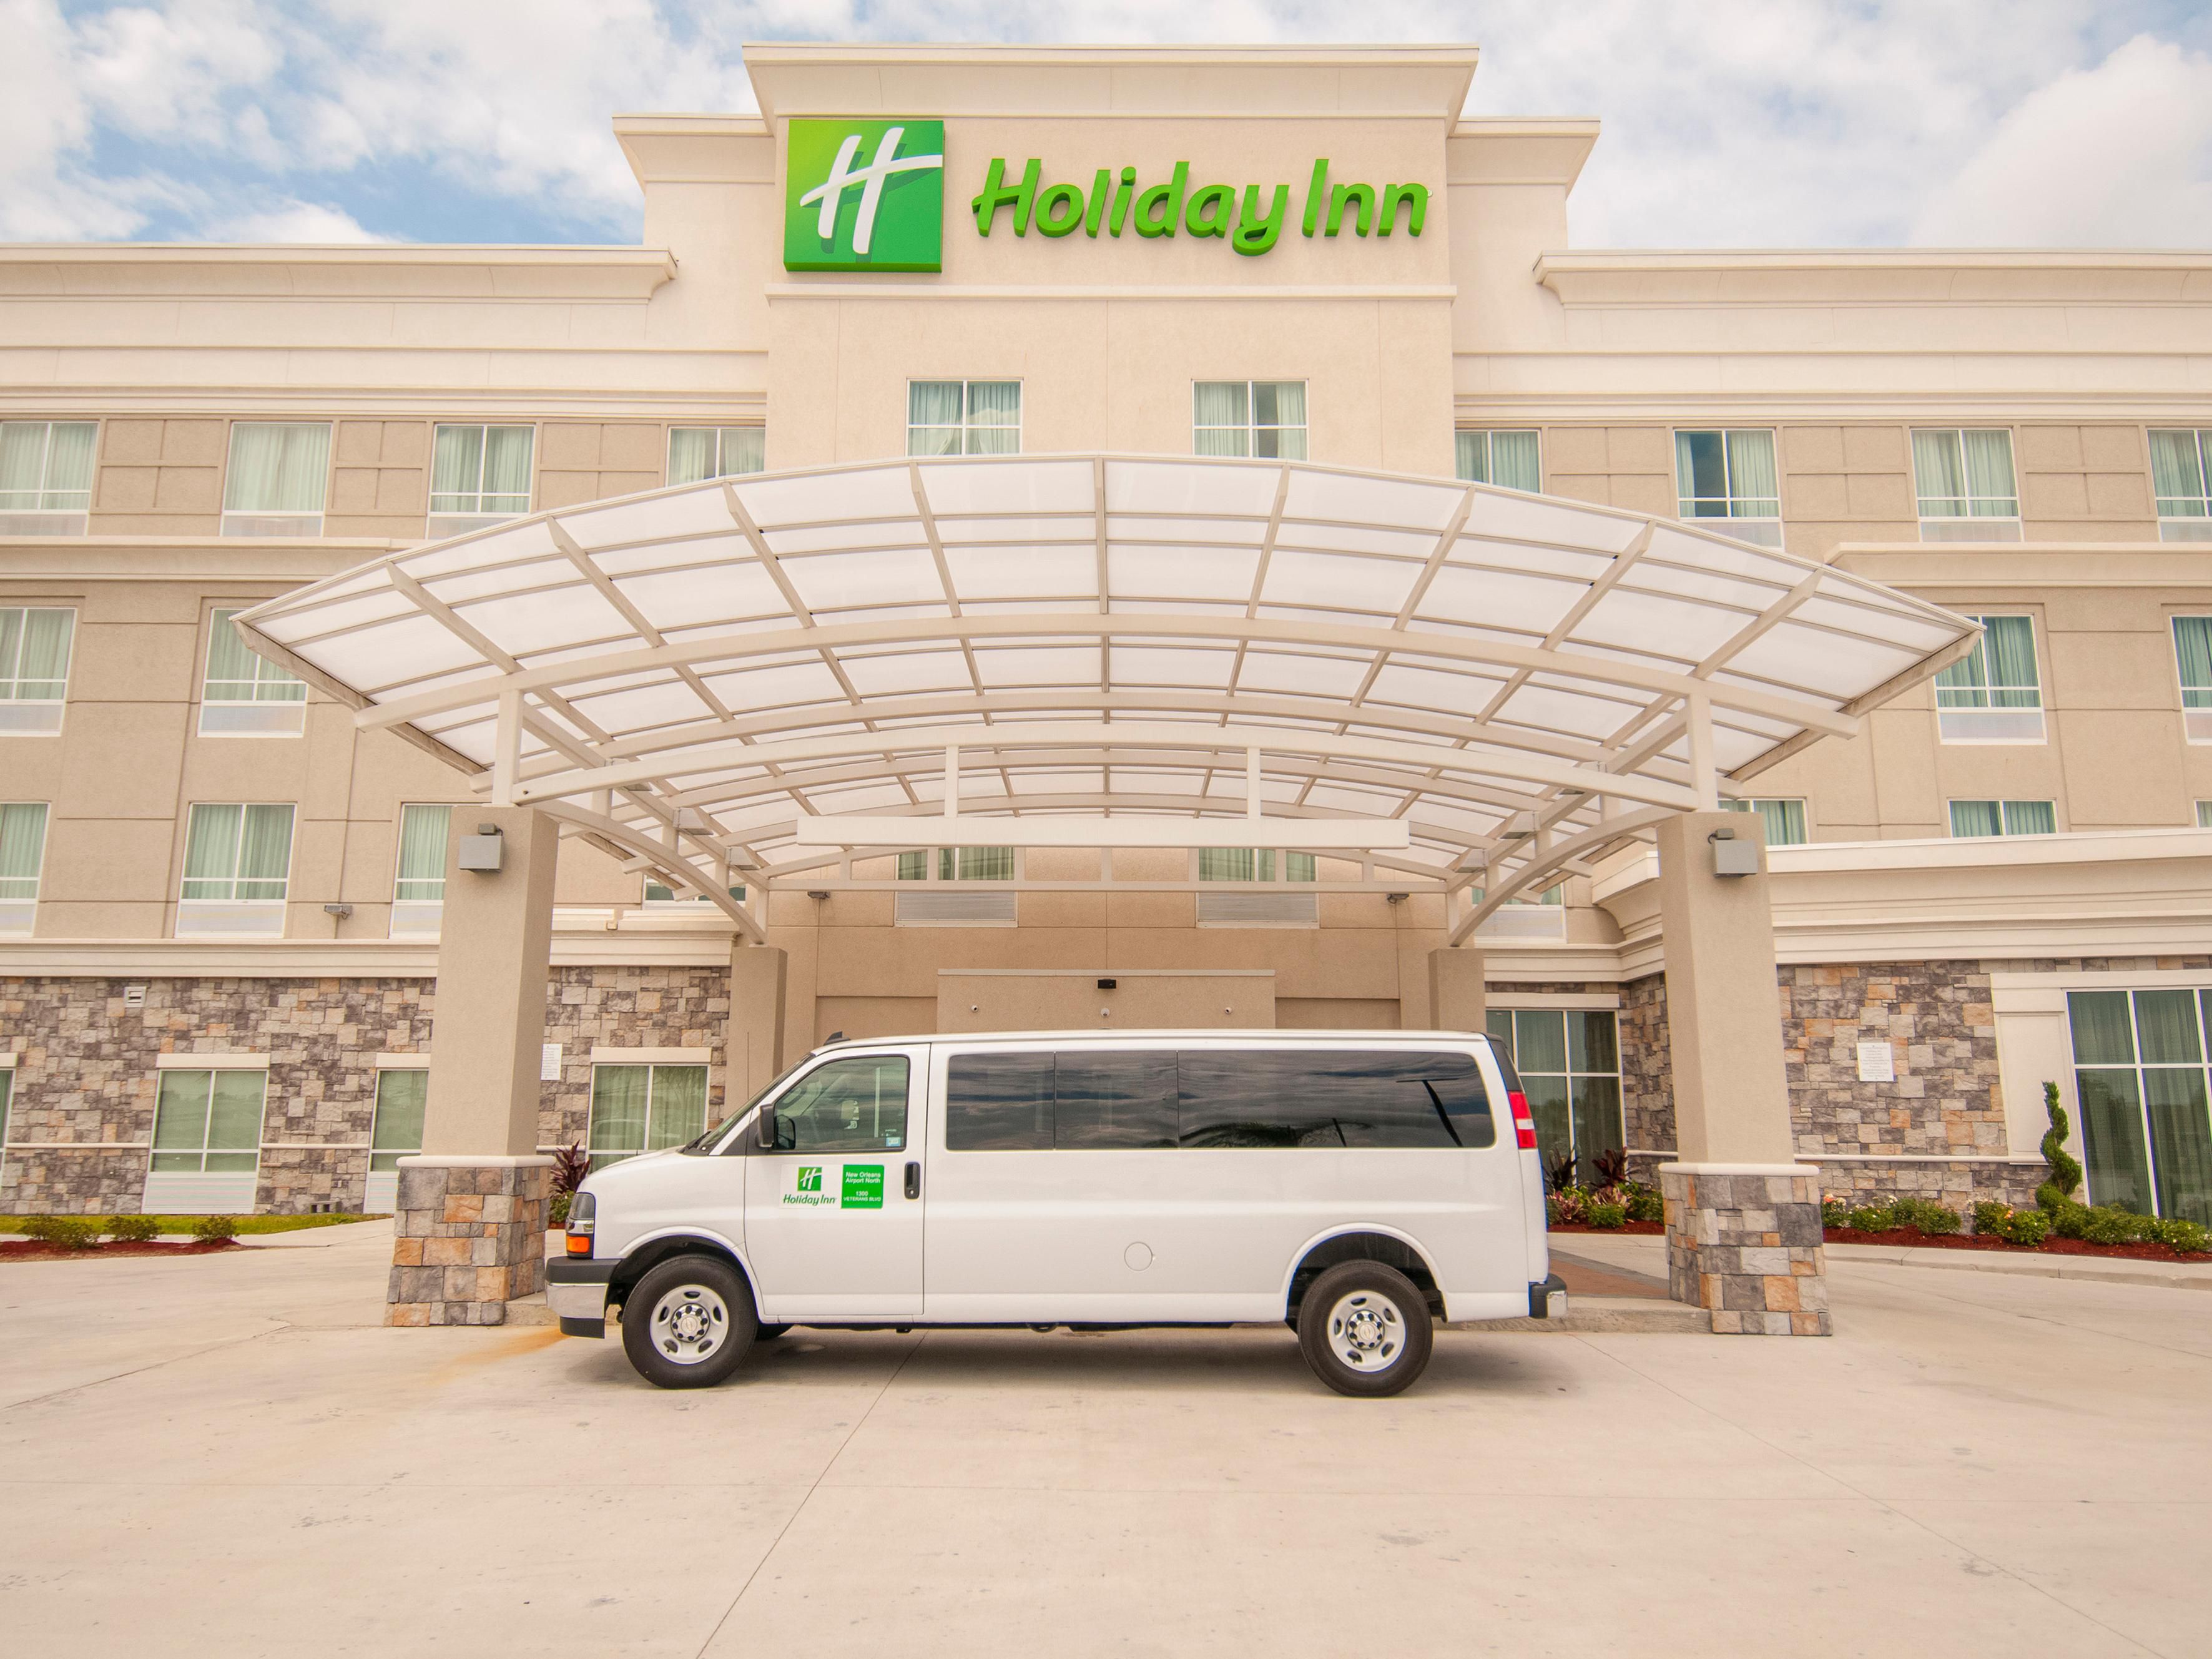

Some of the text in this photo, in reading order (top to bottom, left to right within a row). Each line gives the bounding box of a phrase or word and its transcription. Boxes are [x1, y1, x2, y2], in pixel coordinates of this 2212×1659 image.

[971, 157, 1428, 257] Holiday Inn
[783, 1194, 836, 1206] Holiday Inn
